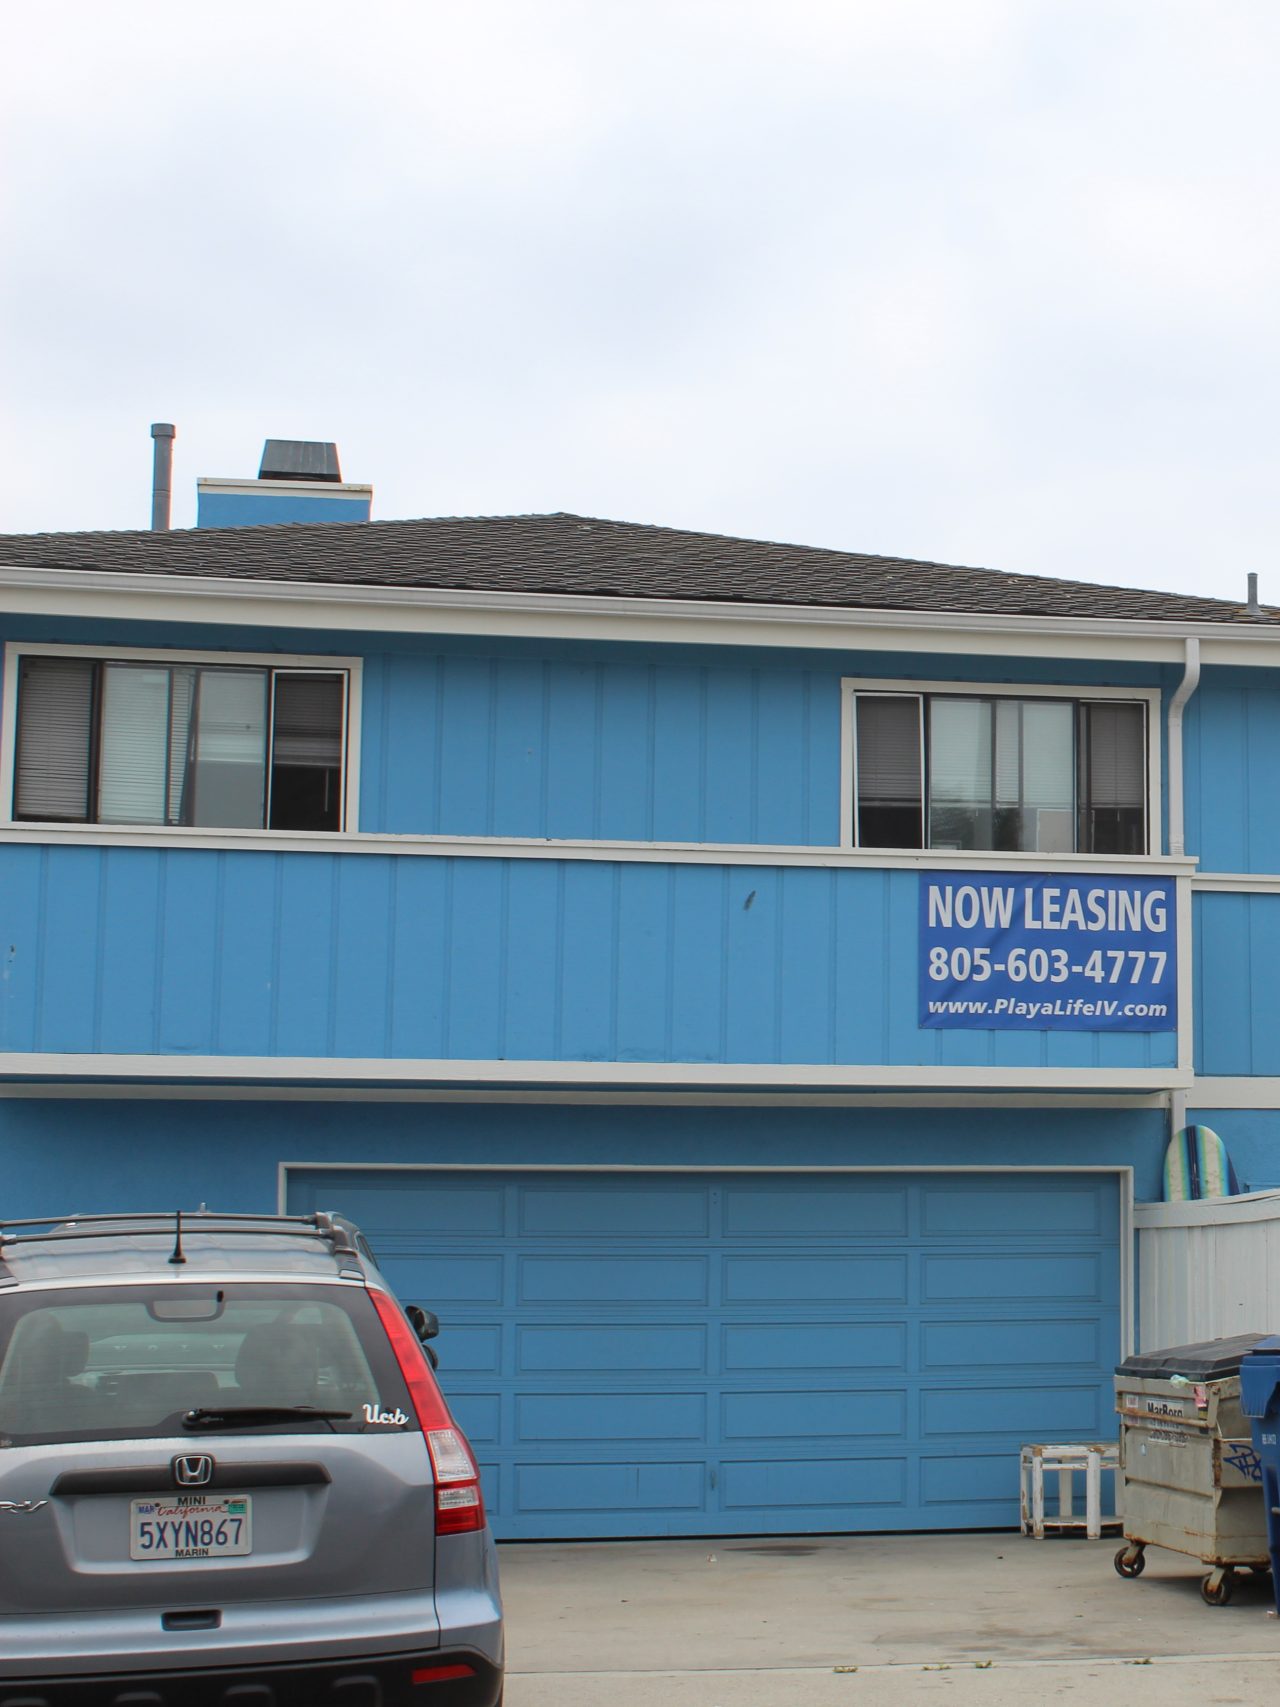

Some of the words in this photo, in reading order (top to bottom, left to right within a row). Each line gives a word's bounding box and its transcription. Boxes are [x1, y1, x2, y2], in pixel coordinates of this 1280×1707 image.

[928, 885, 1015, 929] NOW
[1024, 887, 1167, 932] LEASING
[928, 946, 1167, 984] 805-603-4777
[928, 998, 1167, 1019] www.PlayaLifeIV.com
[178, 1496, 206, 1505] MINI
[157, 1505, 229, 1519] California
[140, 1518, 243, 1549] 5XYN867
[175, 1548, 209, 1557] MARIN
